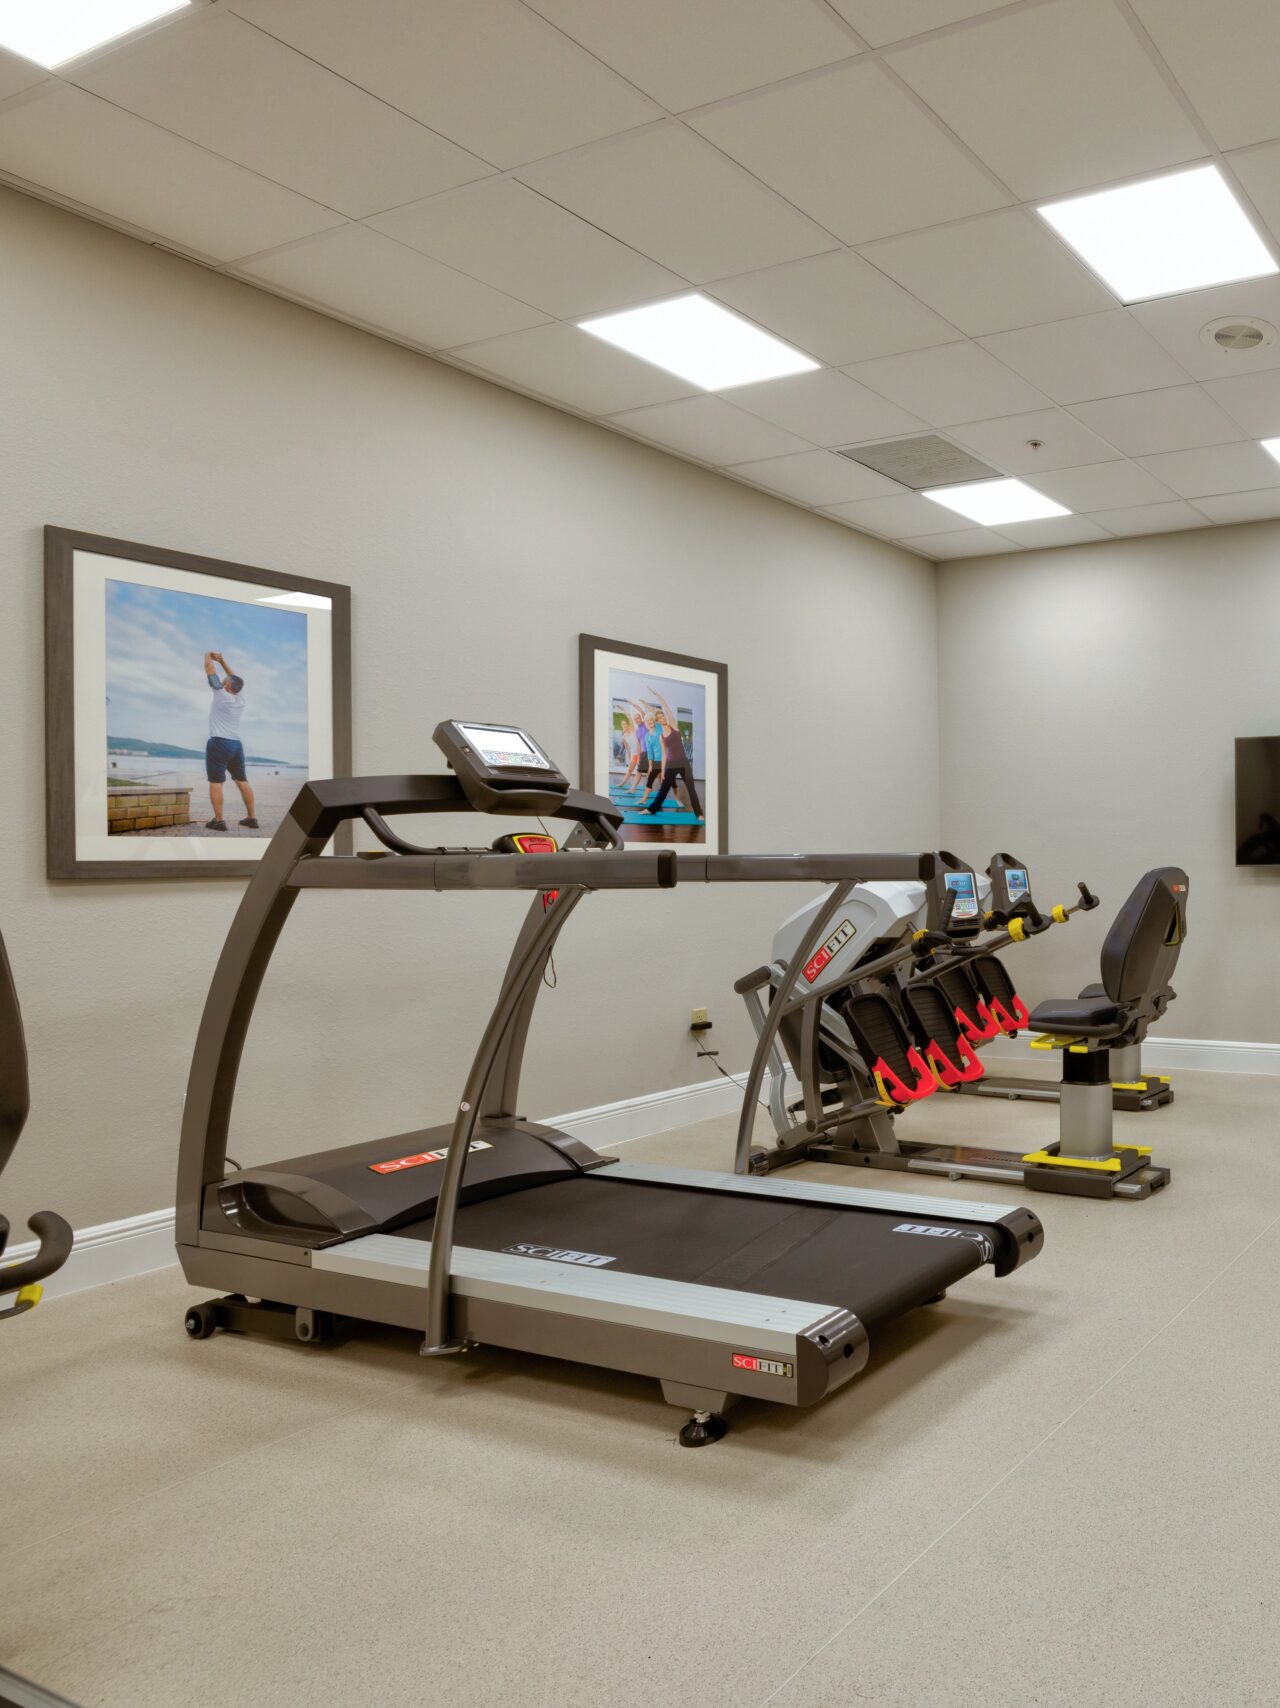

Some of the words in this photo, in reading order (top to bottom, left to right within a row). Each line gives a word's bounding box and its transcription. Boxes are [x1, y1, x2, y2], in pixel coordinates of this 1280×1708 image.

[806, 924, 848, 979] SCIFIT
[509, 1244, 610, 1263] SCIFIT
[733, 1356, 783, 1374] SCIFIT
